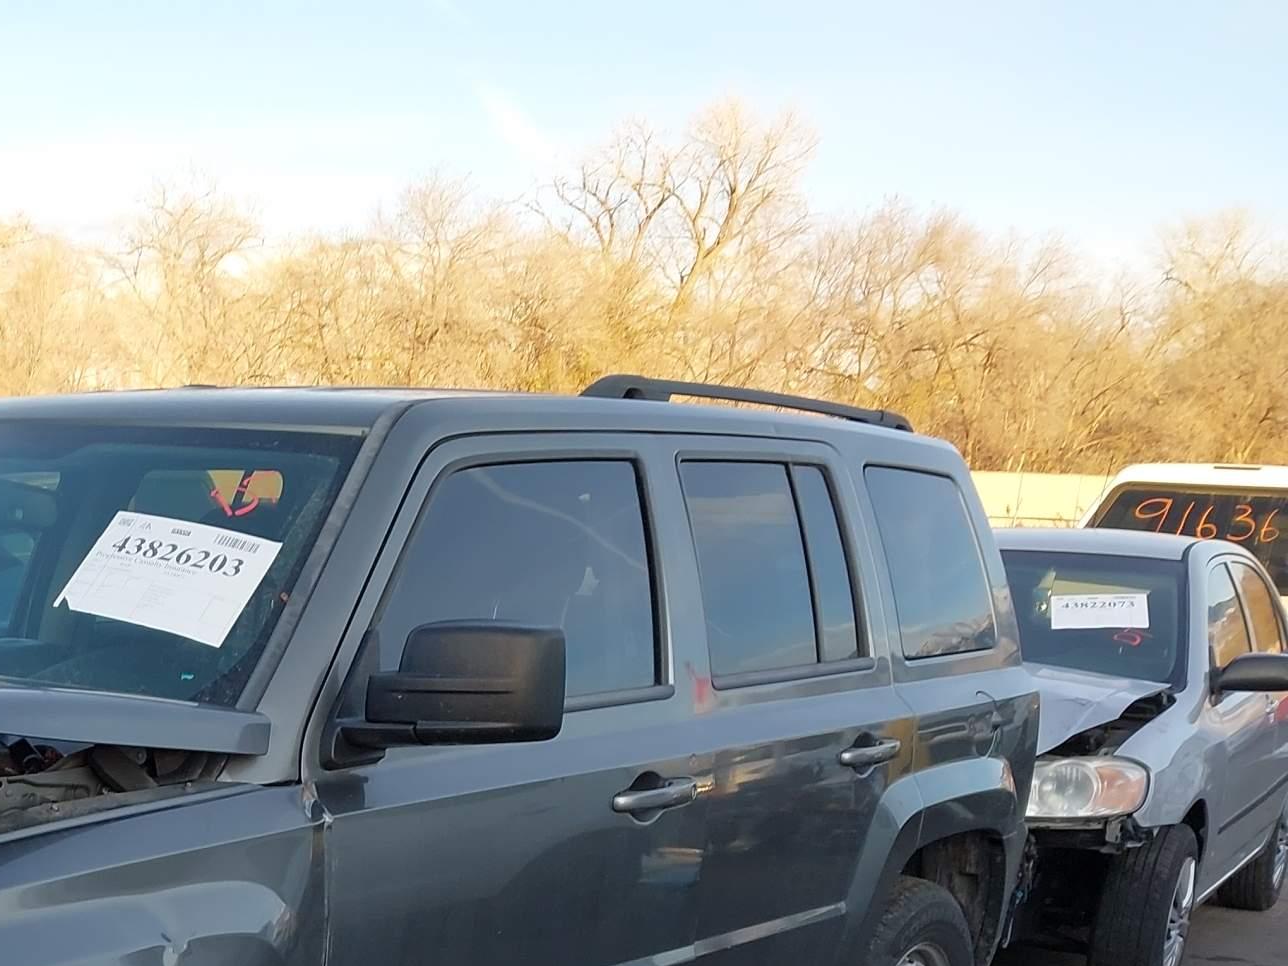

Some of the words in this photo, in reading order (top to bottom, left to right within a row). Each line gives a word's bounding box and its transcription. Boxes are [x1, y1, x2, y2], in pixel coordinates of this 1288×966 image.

[1135, 497, 1280, 543] 91636
[112, 535, 244, 577] 43826203
[1061, 601, 1136, 609] 43822073
